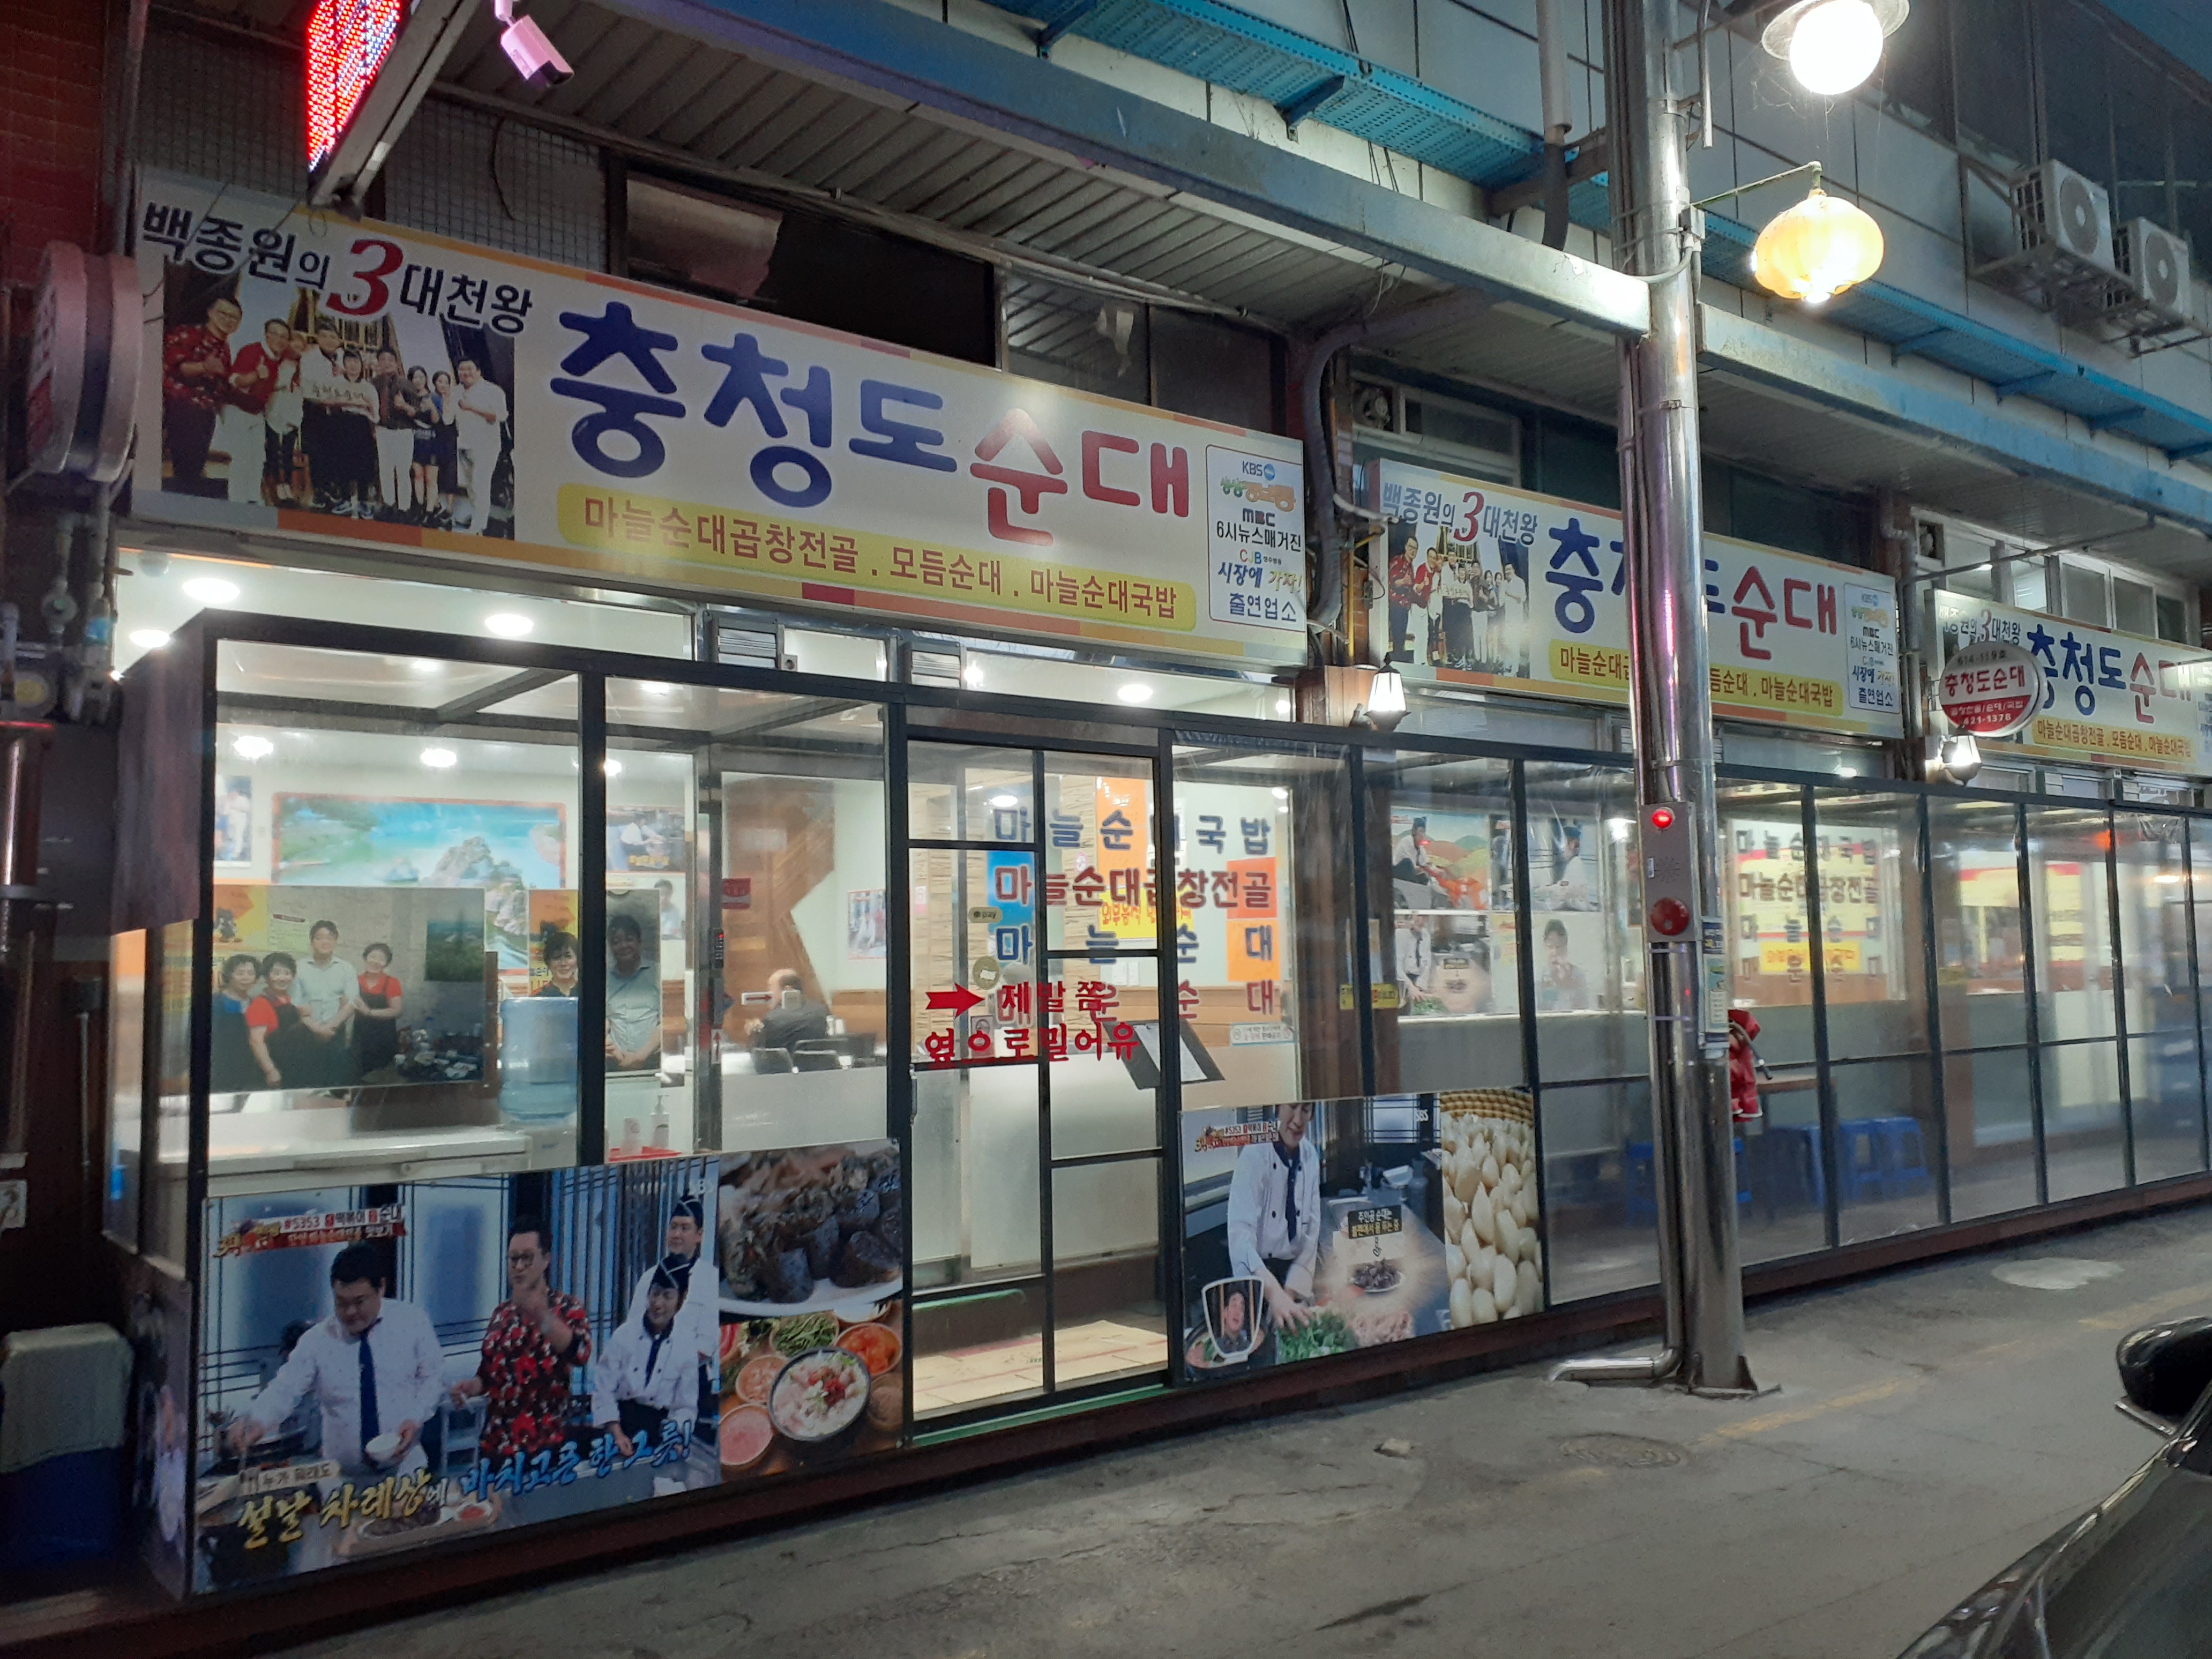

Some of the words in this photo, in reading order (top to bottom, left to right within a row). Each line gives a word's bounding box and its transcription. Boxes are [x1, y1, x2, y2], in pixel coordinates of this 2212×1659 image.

[144, 201, 330, 292] 백종원의
[1242, 460, 1263, 477] KBS
[1242, 507, 1275, 527] MBC
[1382, 482, 1456, 527] 백종원의
[585, 496, 858, 574] 마늘순대곱창전골
[890, 545, 1002, 596] 모듬순대
[1239, 549, 1262, 564] CJB
[1217, 561, 1263, 589] 시장에
[1031, 567, 1177, 619] 마늘순대국밥
[1229, 592, 1297, 622] 출연업소
[1761, 676, 1833, 708] 마늘순대국밥
[1858, 687, 1893, 707] 출연업소
[1945, 666, 2025, 697] 충청도순대
[589, 1432, 619, 1478] 한
